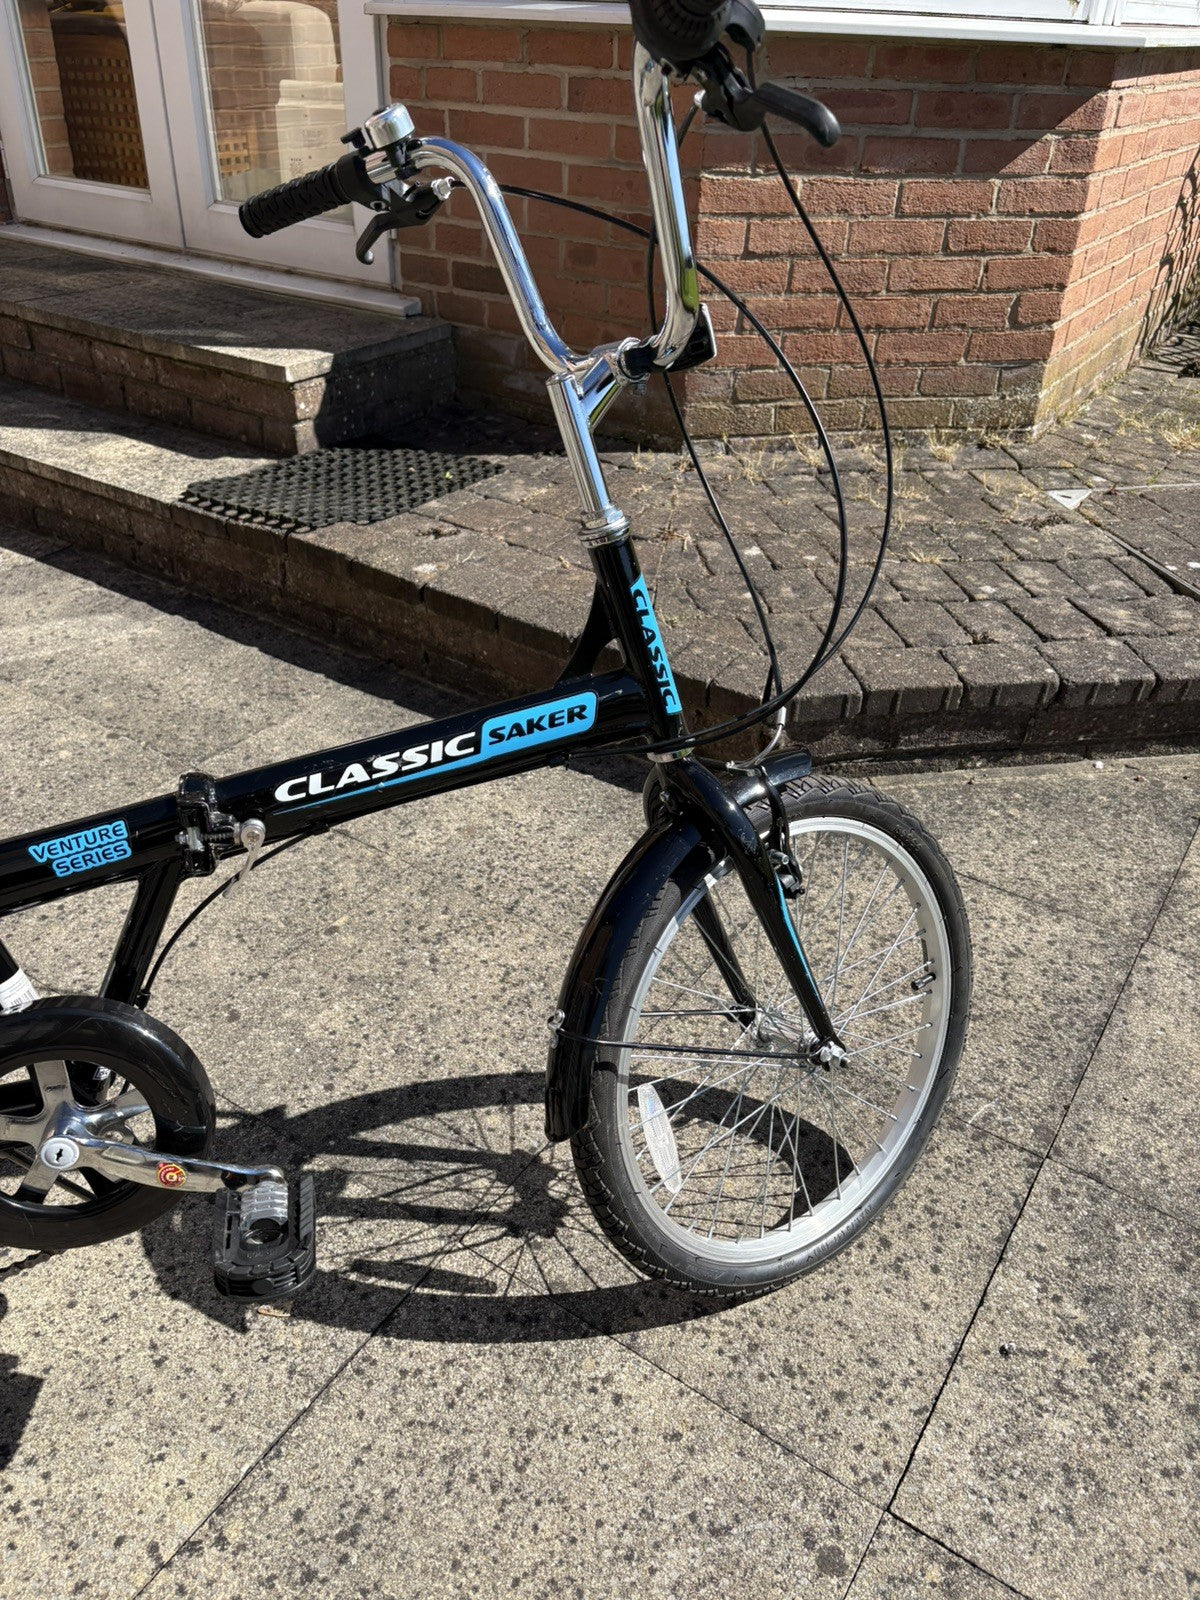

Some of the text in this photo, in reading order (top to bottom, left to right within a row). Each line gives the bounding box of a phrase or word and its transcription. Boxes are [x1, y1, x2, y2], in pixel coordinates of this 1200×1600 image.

[632, 588, 677, 707] CLASSIC
[274, 704, 588, 802] CLASSIC SAKER
[31, 822, 125, 860] VENTURE
[55, 844, 128, 874] SERIES
